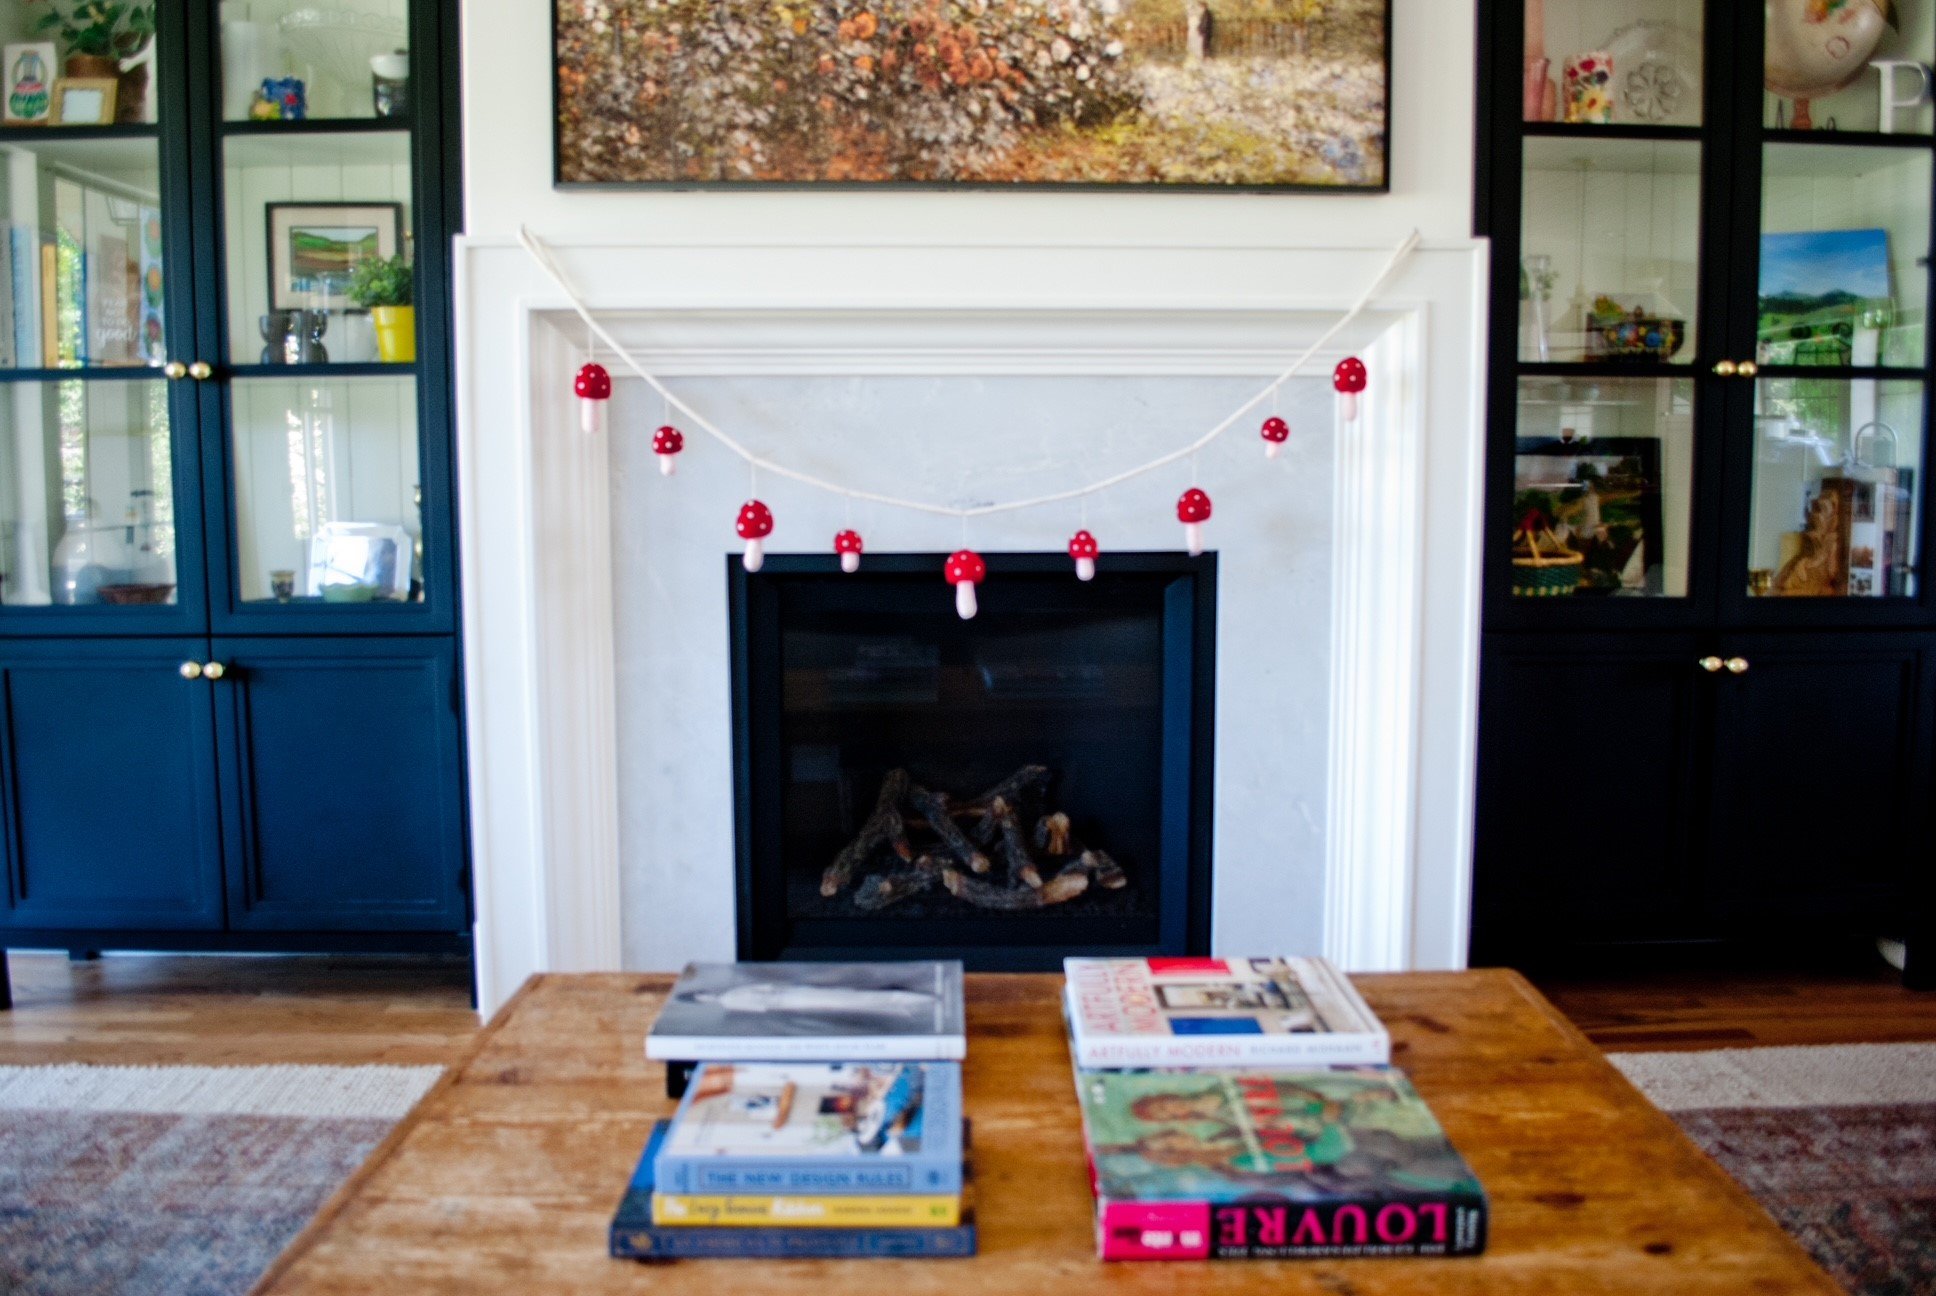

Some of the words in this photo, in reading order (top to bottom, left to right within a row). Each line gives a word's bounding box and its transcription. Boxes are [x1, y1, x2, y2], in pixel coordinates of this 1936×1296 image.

[1868, 61, 1931, 134] P
[1088, 1044, 1161, 1059] ARTFULLY
[1168, 1043, 1241, 1057] MODERN
[707, 1172, 736, 1186] THE
[743, 1172, 782, 1186] NEW
[790, 1173, 850, 1187] DESIGN
[856, 1172, 905, 1187] RULES
[1215, 1203, 1449, 1247] LOUVRE
